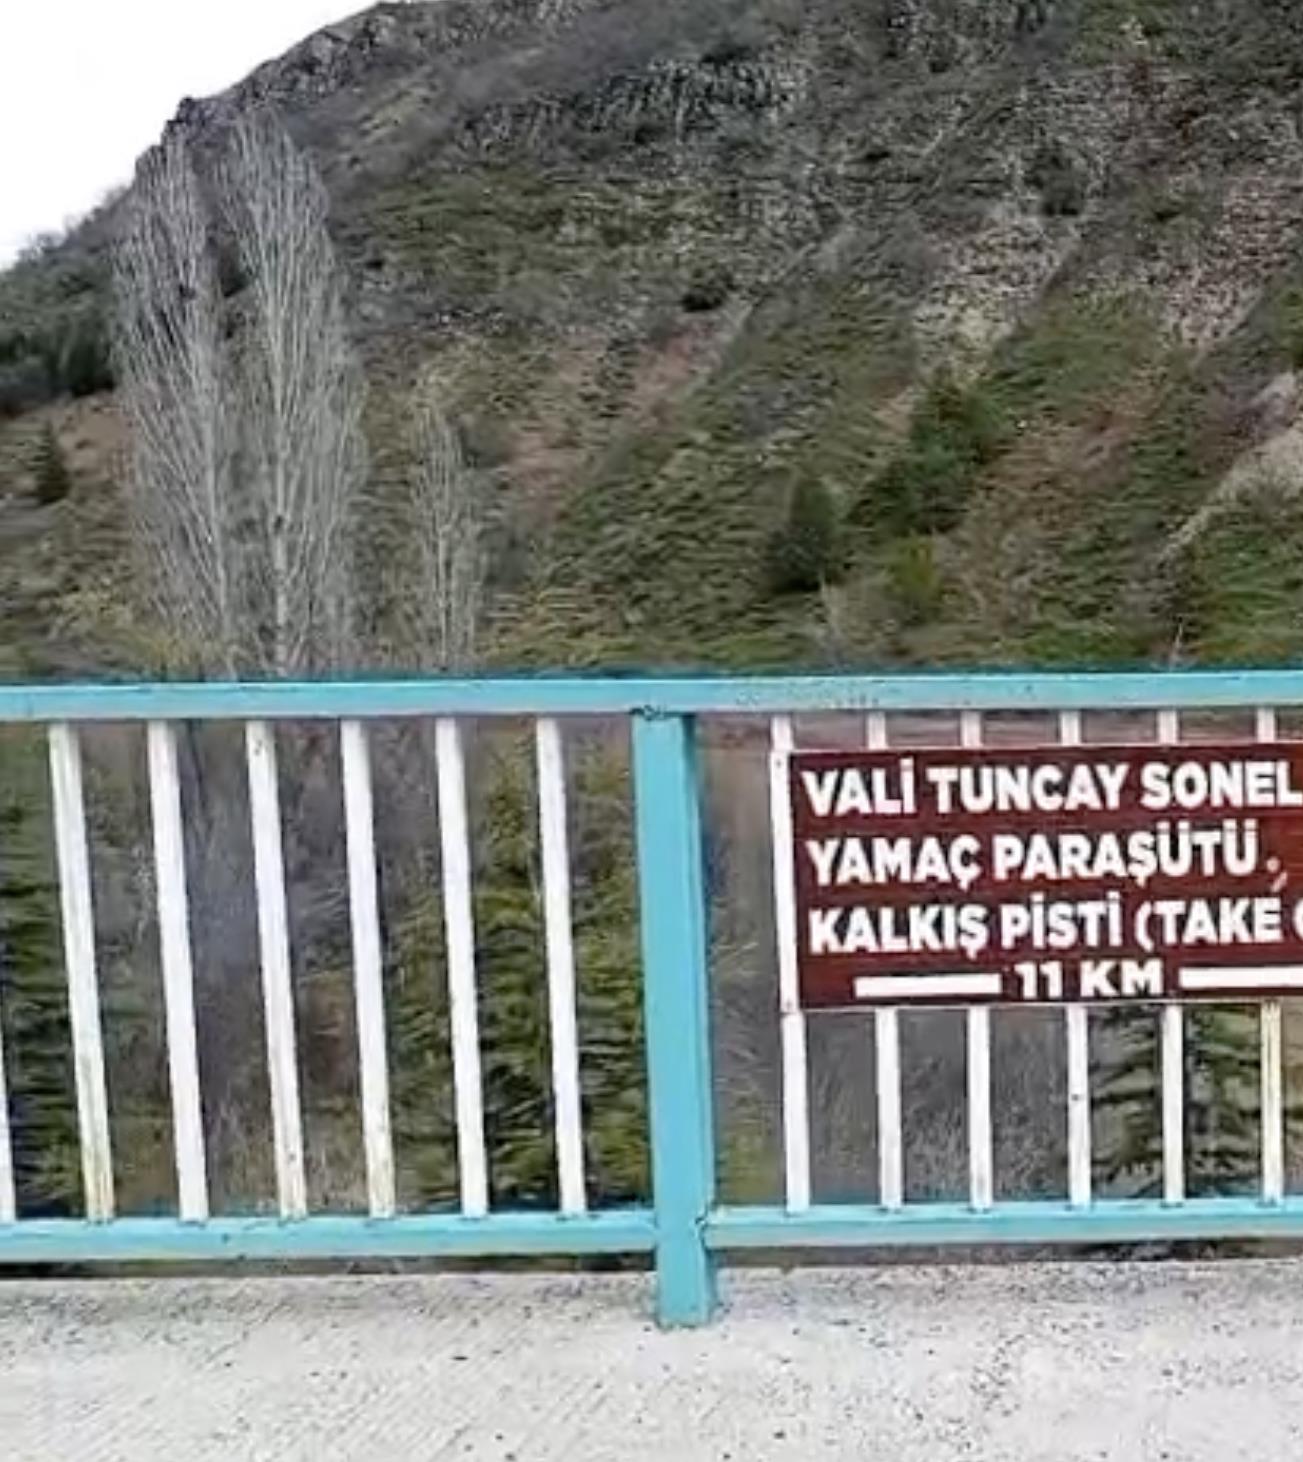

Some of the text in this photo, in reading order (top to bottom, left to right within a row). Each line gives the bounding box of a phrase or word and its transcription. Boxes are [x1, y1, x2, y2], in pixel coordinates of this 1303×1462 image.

[800, 757, 916, 816] VALİ
[925, 762, 1130, 814] TUNCAY
[804, 819, 1258, 891] YAMAÇ PARAŞÜTÜ
[807, 904, 989, 960] KALKIŞ
[1000, 890, 1123, 949] PİSTİ
[1134, 896, 1284, 953] (TAKE
[1013, 959, 1164, 1000] 11 KM
